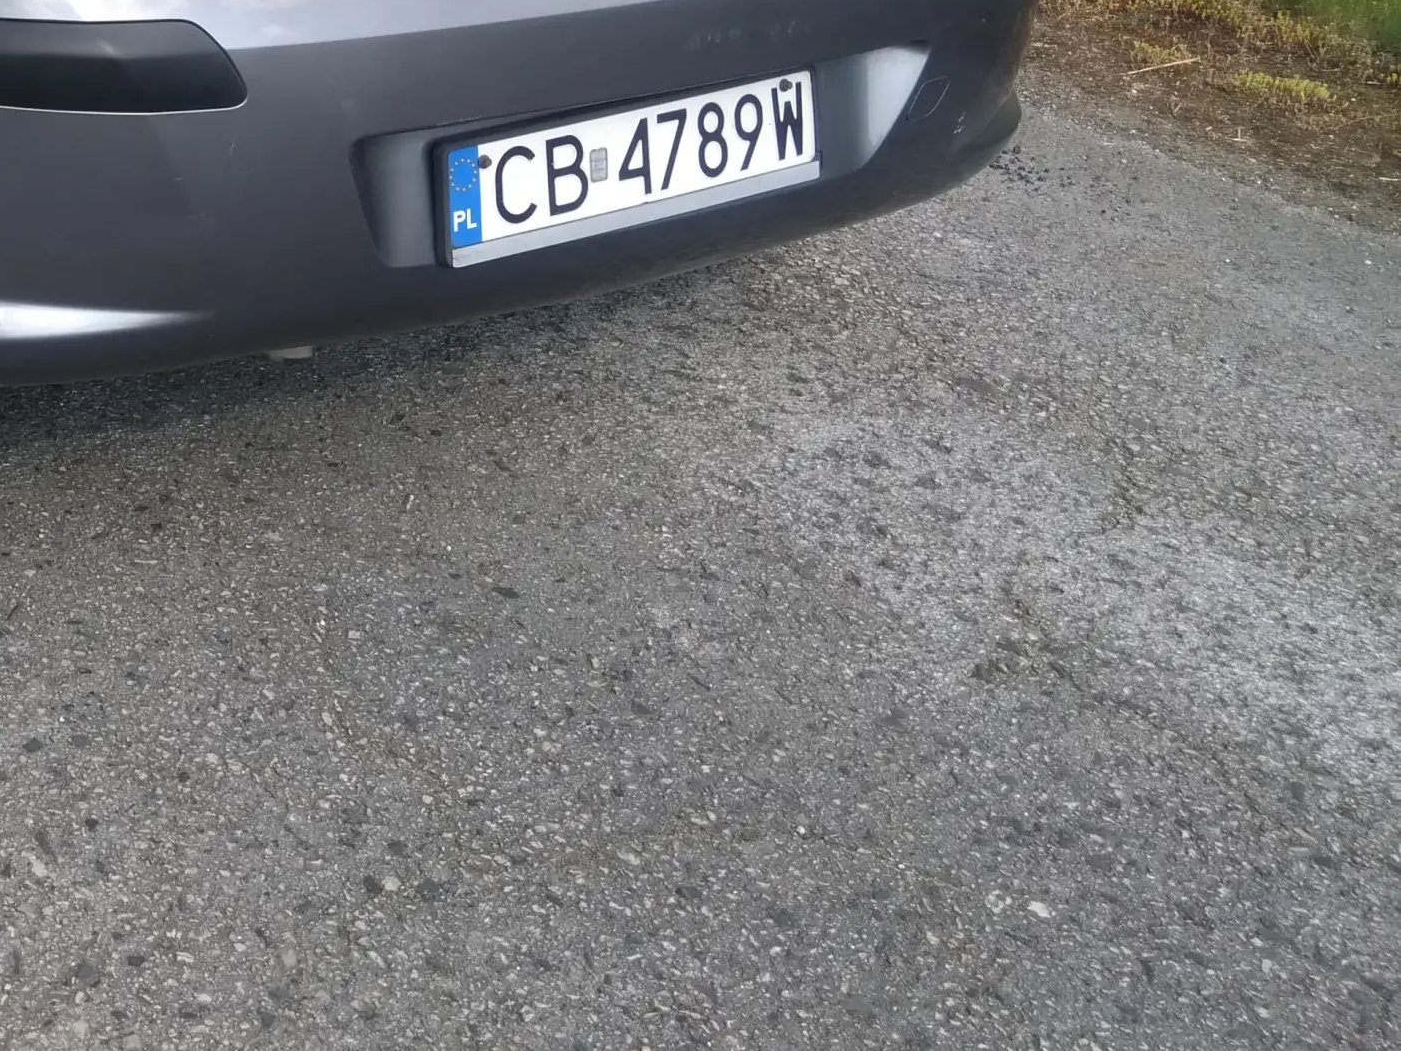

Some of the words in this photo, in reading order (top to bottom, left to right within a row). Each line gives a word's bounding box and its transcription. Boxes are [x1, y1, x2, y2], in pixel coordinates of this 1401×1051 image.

[494, 134, 589, 224] CB
[618, 81, 804, 195] 4789W
[452, 208, 478, 233] PL
